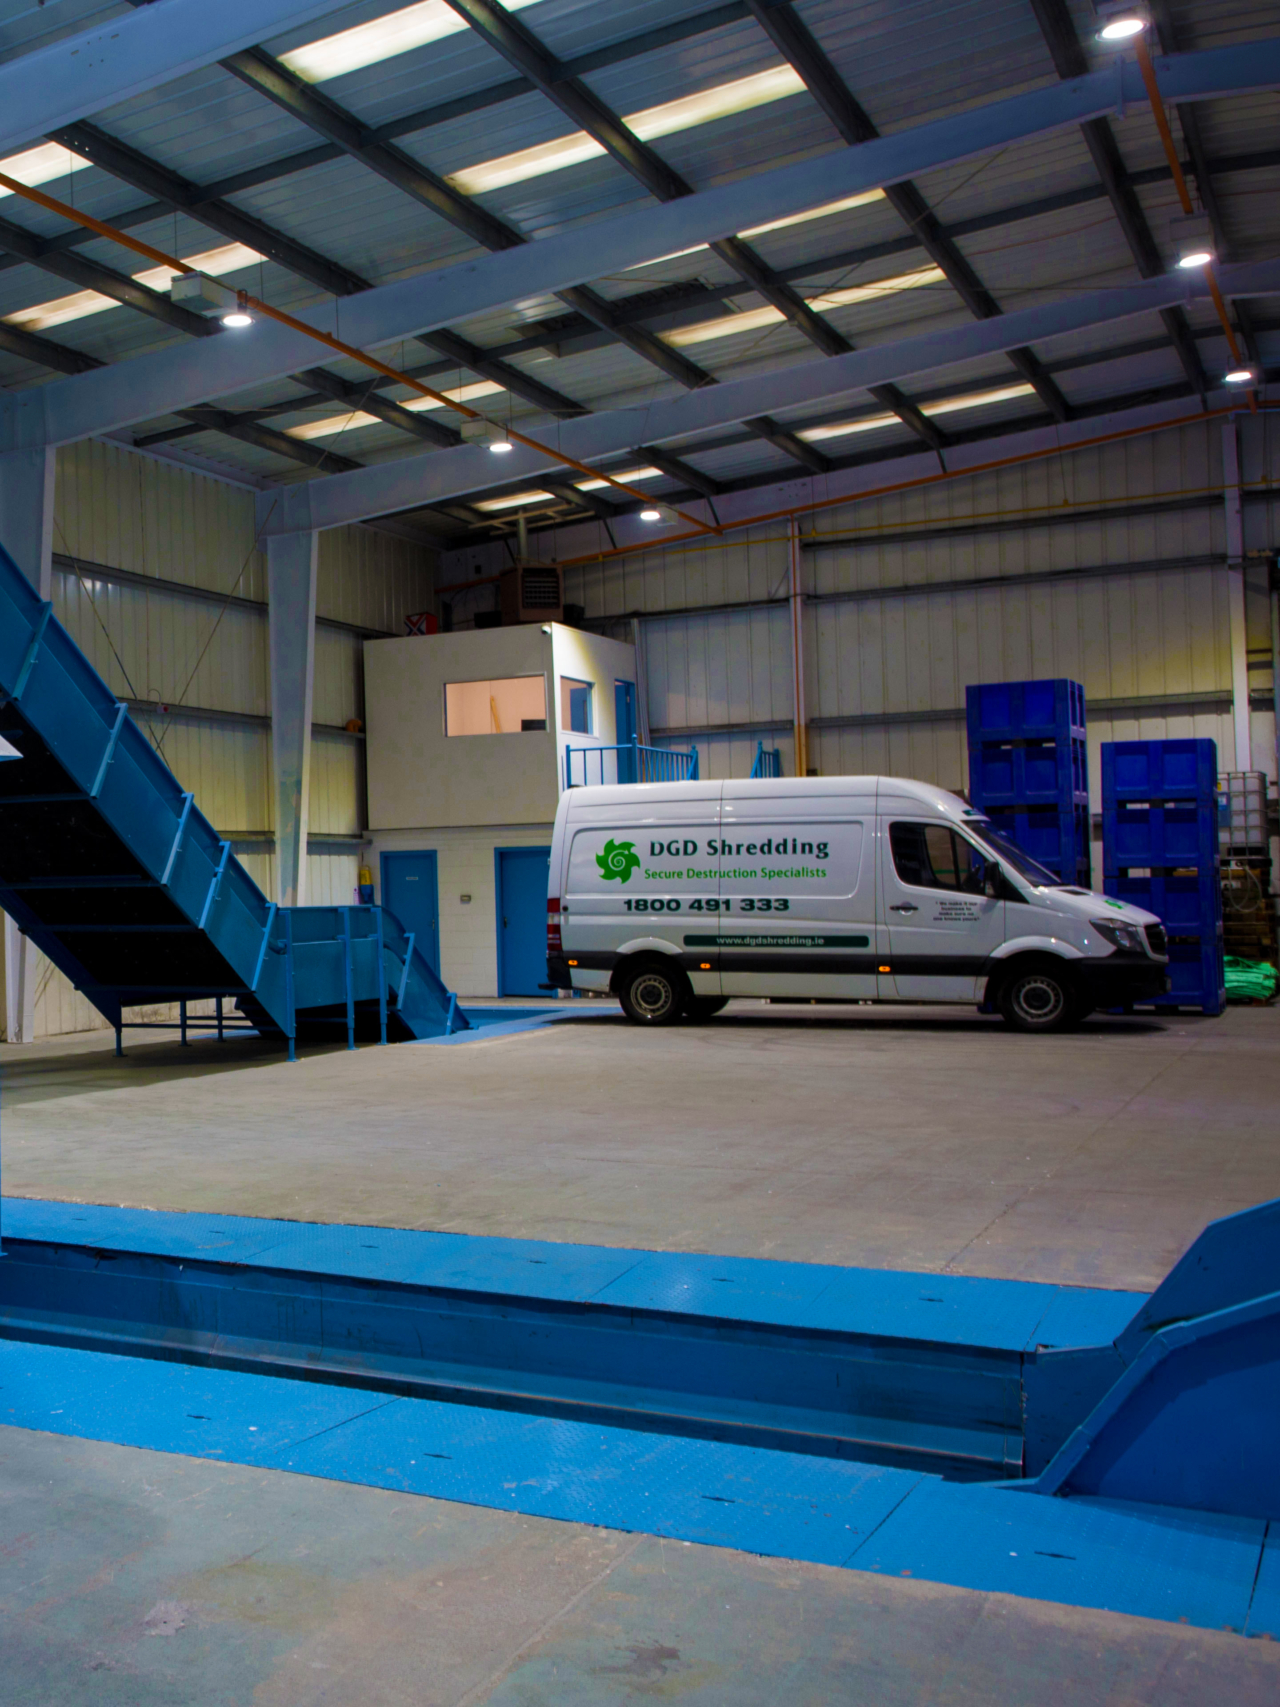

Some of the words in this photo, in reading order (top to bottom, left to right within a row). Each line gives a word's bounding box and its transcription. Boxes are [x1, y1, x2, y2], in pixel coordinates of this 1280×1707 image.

[649, 839, 698, 857] DGD
[706, 838, 829, 859] Shredding
[644, 868, 683, 879] Secure
[686, 868, 757, 879] Destruction
[760, 867, 827, 880] Specialists
[623, 898, 681, 912] 1800
[688, 898, 732, 912] 491
[740, 898, 790, 912] 333
[717, 936, 825, 946] www.dgdshredding.ie
